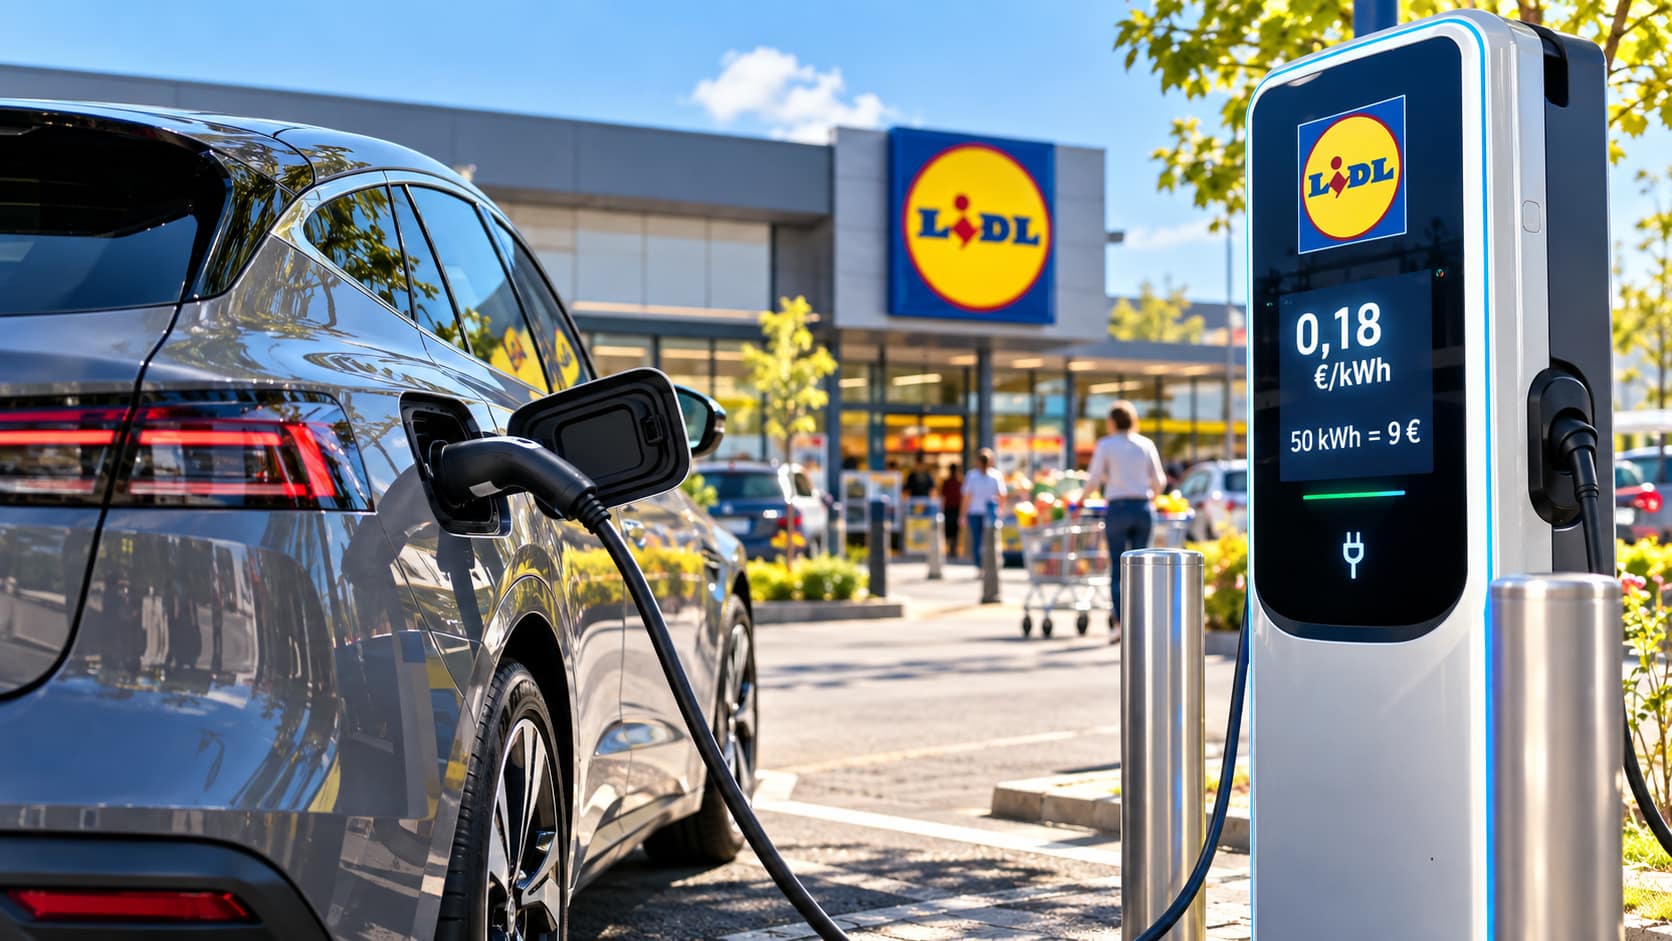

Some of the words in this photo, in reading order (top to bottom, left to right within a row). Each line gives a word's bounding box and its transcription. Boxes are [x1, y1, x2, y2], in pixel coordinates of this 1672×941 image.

[1296, 302, 1382, 360] 0,18
[1314, 357, 1391, 391] €/kWh
[1290, 430, 1313, 453] 50
[1318, 424, 1361, 451] kWh
[1368, 430, 1381, 441] =
[1387, 420, 1401, 445] 9
[1406, 418, 1421, 444] €
